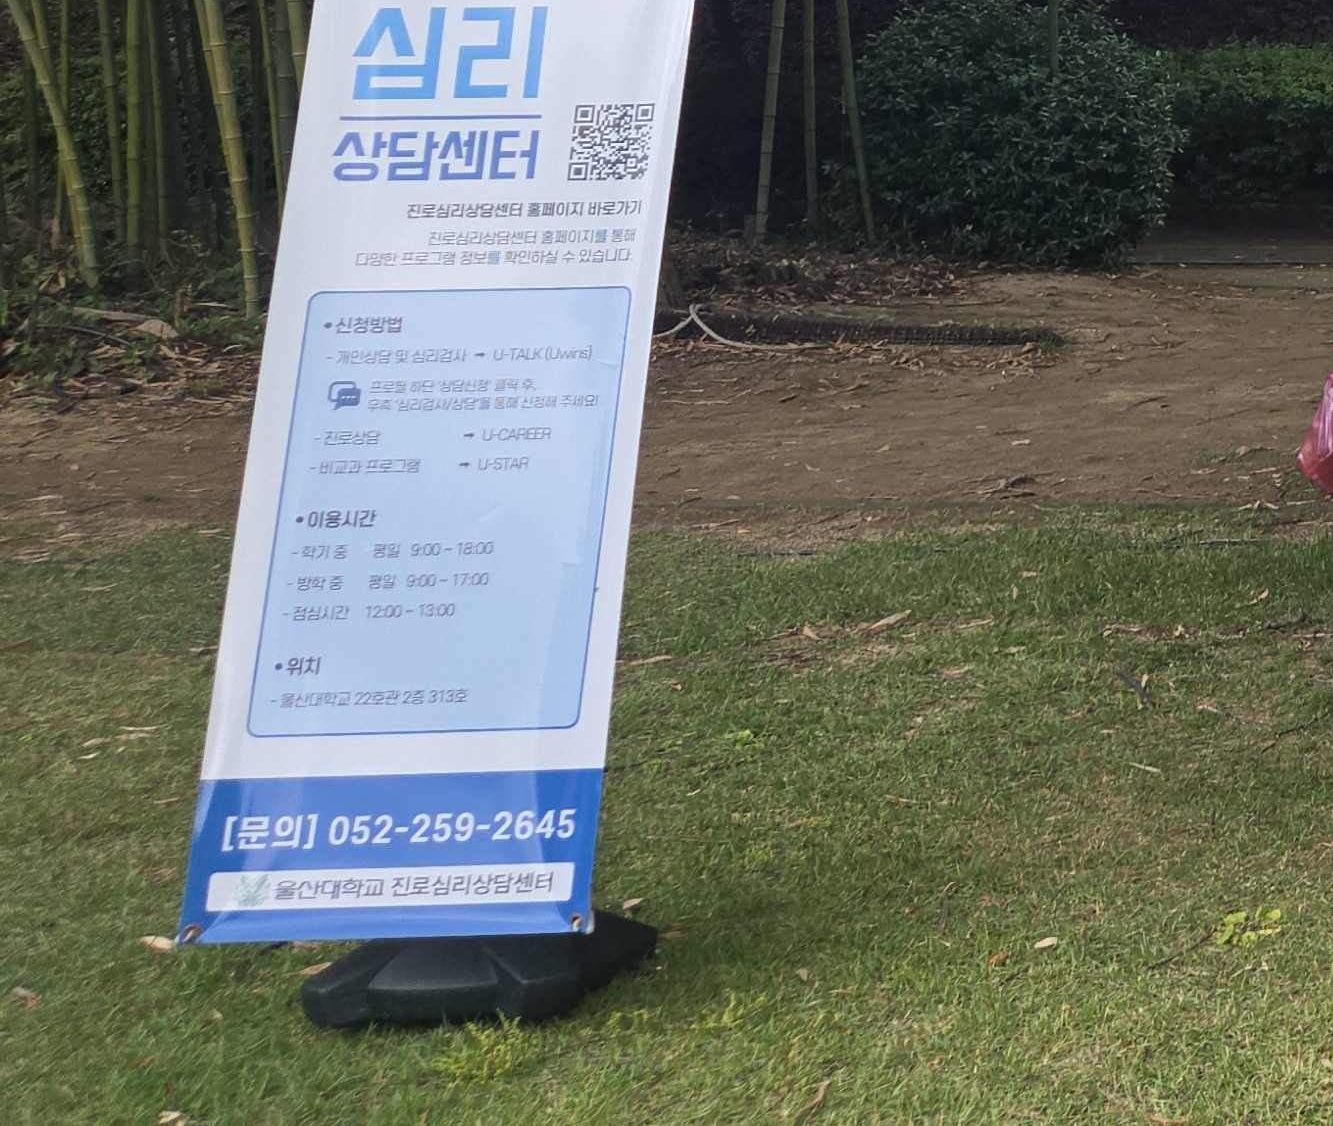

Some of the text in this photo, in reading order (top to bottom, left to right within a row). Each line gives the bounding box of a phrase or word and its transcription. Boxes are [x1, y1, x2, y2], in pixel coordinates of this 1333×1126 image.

[352, 5, 549, 100] 심리
[332, 129, 540, 182] 상담센터
[407, 200, 643, 219] 진로심리상담센터 홈페이지 바로가기
[428, 227, 637, 246] 진로심리상담센터 홈페이지를 통해
[355, 247, 633, 267] 다양한 프로그램 정보를 확인하실 수 있습니다.
[335, 316, 403, 334] 신청방법
[336, 350, 394, 365] 개인상담
[396, 349, 408, 364] 및
[412, 348, 467, 363] 심리검사
[493, 347, 542, 361] U-TALK
[410, 379, 435, 393] 하단
[521, 395, 557, 409] 신청해
[560, 394, 598, 408] 주세요!
[324, 427, 551, 446] 진로상담 U-CAREER
[319, 457, 530, 475] 비교과 프로그램 U-STAR
[307, 510, 377, 528] 이용시간
[301, 545, 330, 560] 학기
[333, 544, 348, 559] 중
[373, 543, 400, 559] 평일
[410, 542, 441, 557] 9:00
[457, 541, 493, 556] 18:00
[297, 576, 326, 591] 방학
[329, 575, 343, 591] 중
[368, 574, 396, 590] 평일
[406, 573, 436, 588] 9:00
[452, 572, 489, 587] 17:00
[292, 605, 351, 621] 점심시간
[365, 604, 402, 619] 12:00
[419, 603, 455, 617] 13:00
[286, 656, 322, 675] 위치
[280, 688, 469, 708] 울산대학교 22호관 2층 313호
[221, 808, 577, 852] [문의] 052-259-2645
[274, 871, 554, 901] 울산대학교 진로심리상담센터
